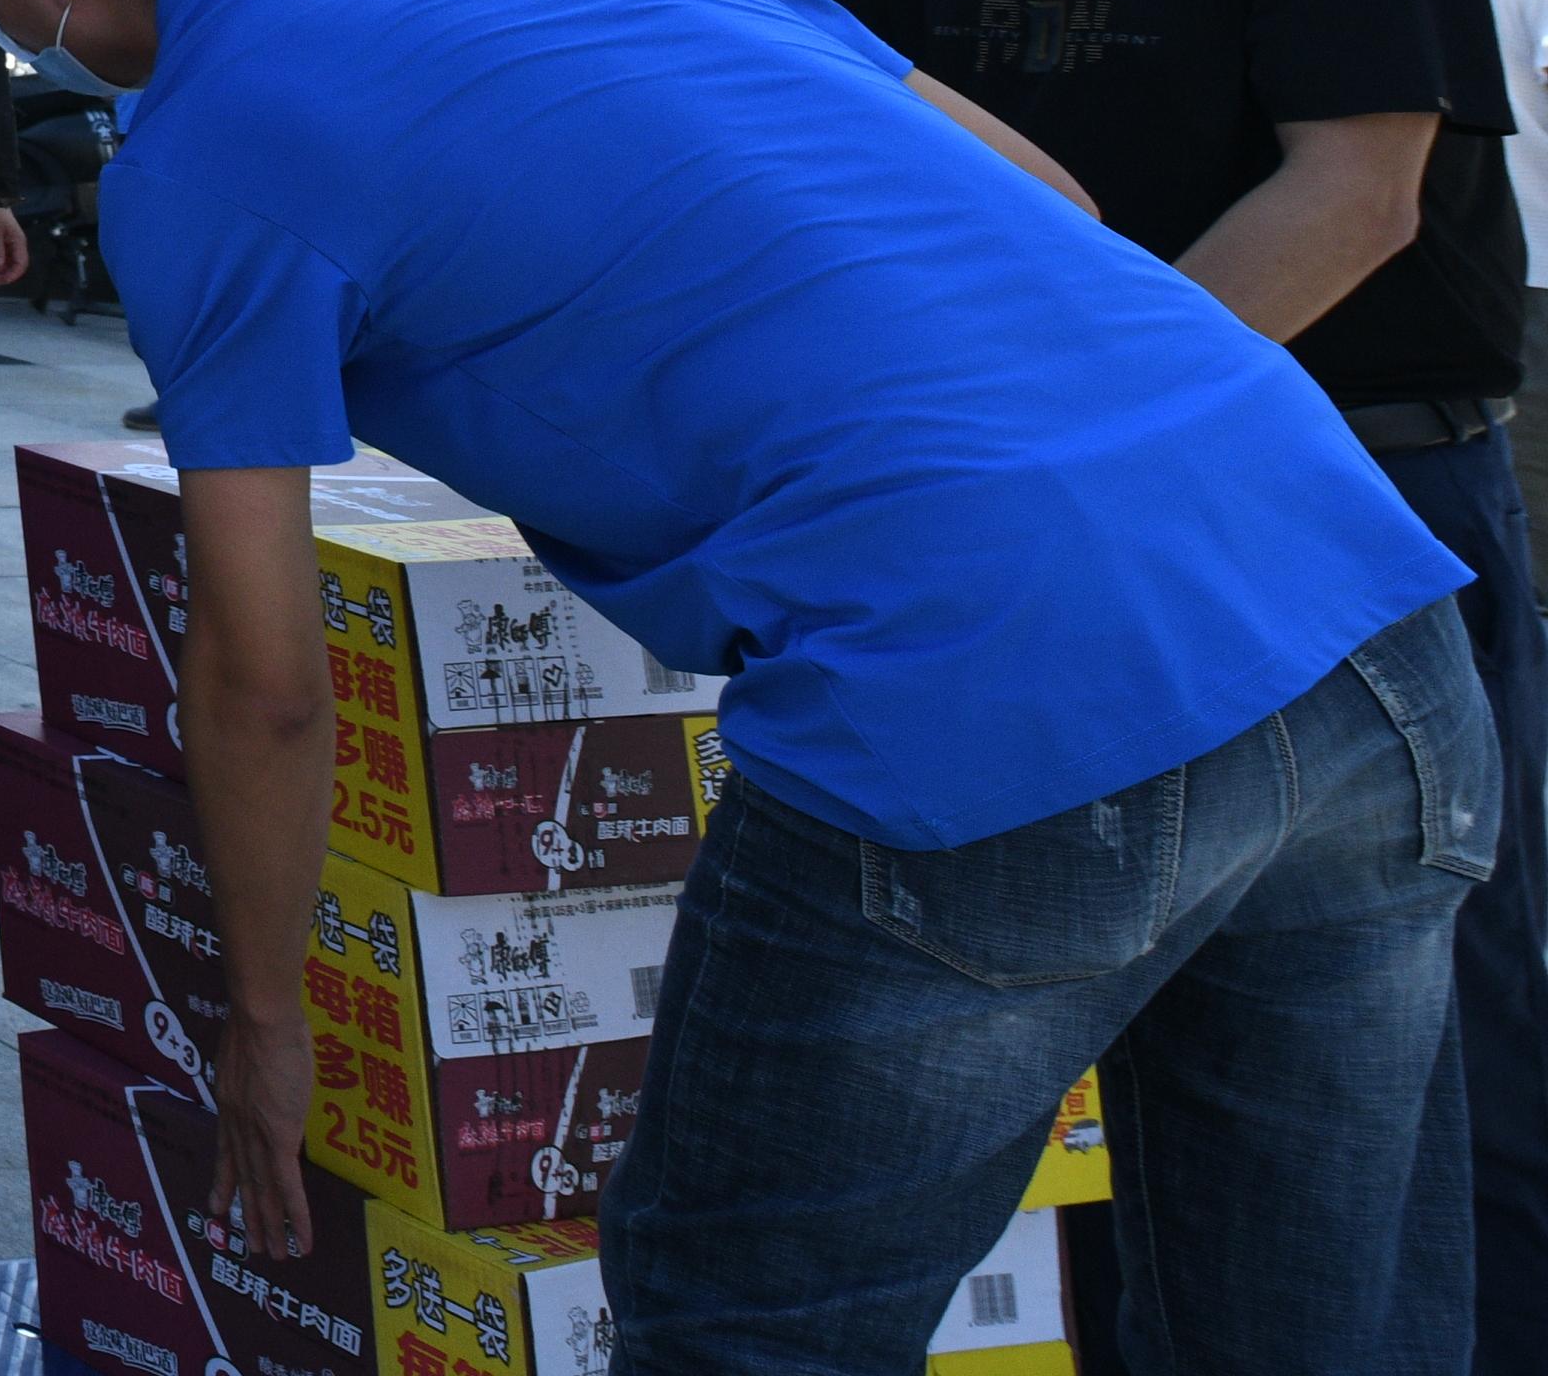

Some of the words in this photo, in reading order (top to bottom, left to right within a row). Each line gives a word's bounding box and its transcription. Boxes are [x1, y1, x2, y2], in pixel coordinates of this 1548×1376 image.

[330, 779, 415, 856] 2.5元
[597, 815, 691, 842] 酸辣牛肉面
[303, 955, 405, 1053] 每箱
[314, 1032, 414, 1128] 多赚
[322, 1100, 420, 1191] 2.5元
[211, 1253, 363, 1357] 酸辣牛肉面
[381, 1247, 511, 1367] 多送一袋
